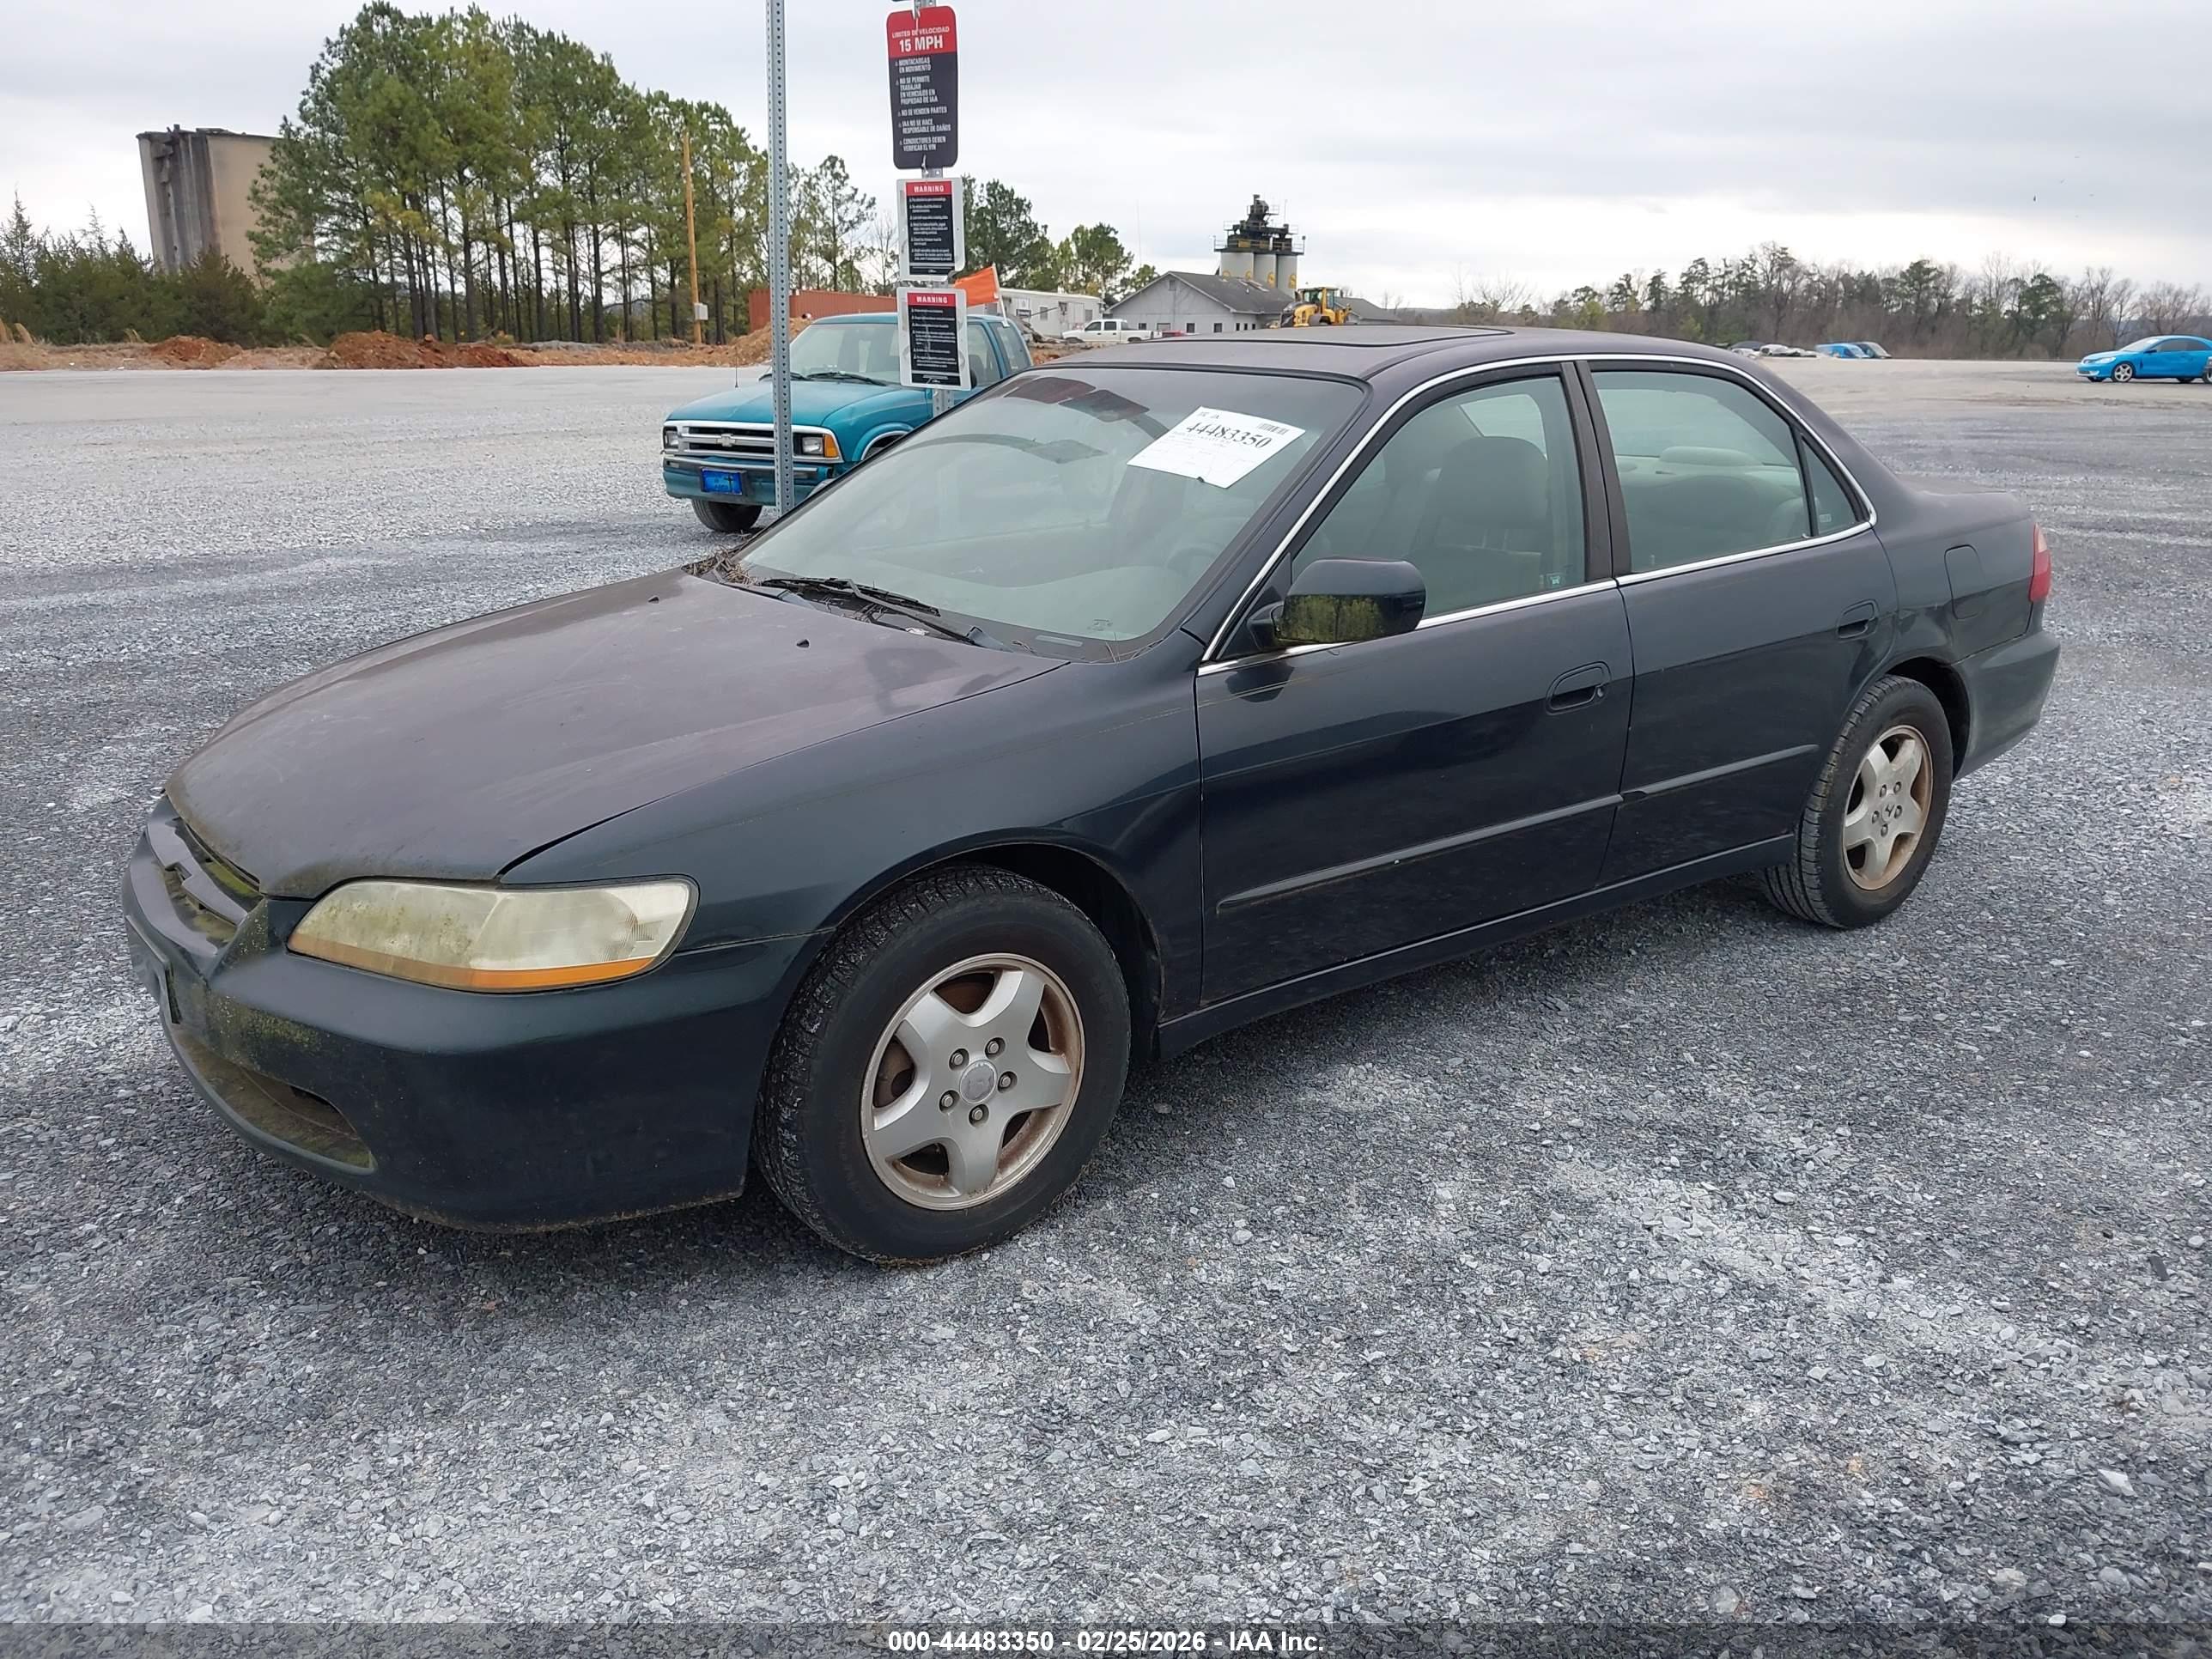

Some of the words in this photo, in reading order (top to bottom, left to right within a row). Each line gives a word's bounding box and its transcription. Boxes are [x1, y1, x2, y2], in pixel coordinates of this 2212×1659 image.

[919, 26, 950, 34] VELOCIDAD
[900, 38, 911, 52] 15
[915, 34, 943, 51] MPH
[916, 295, 948, 304] WARNING
[1186, 422, 1273, 448] 44483350
